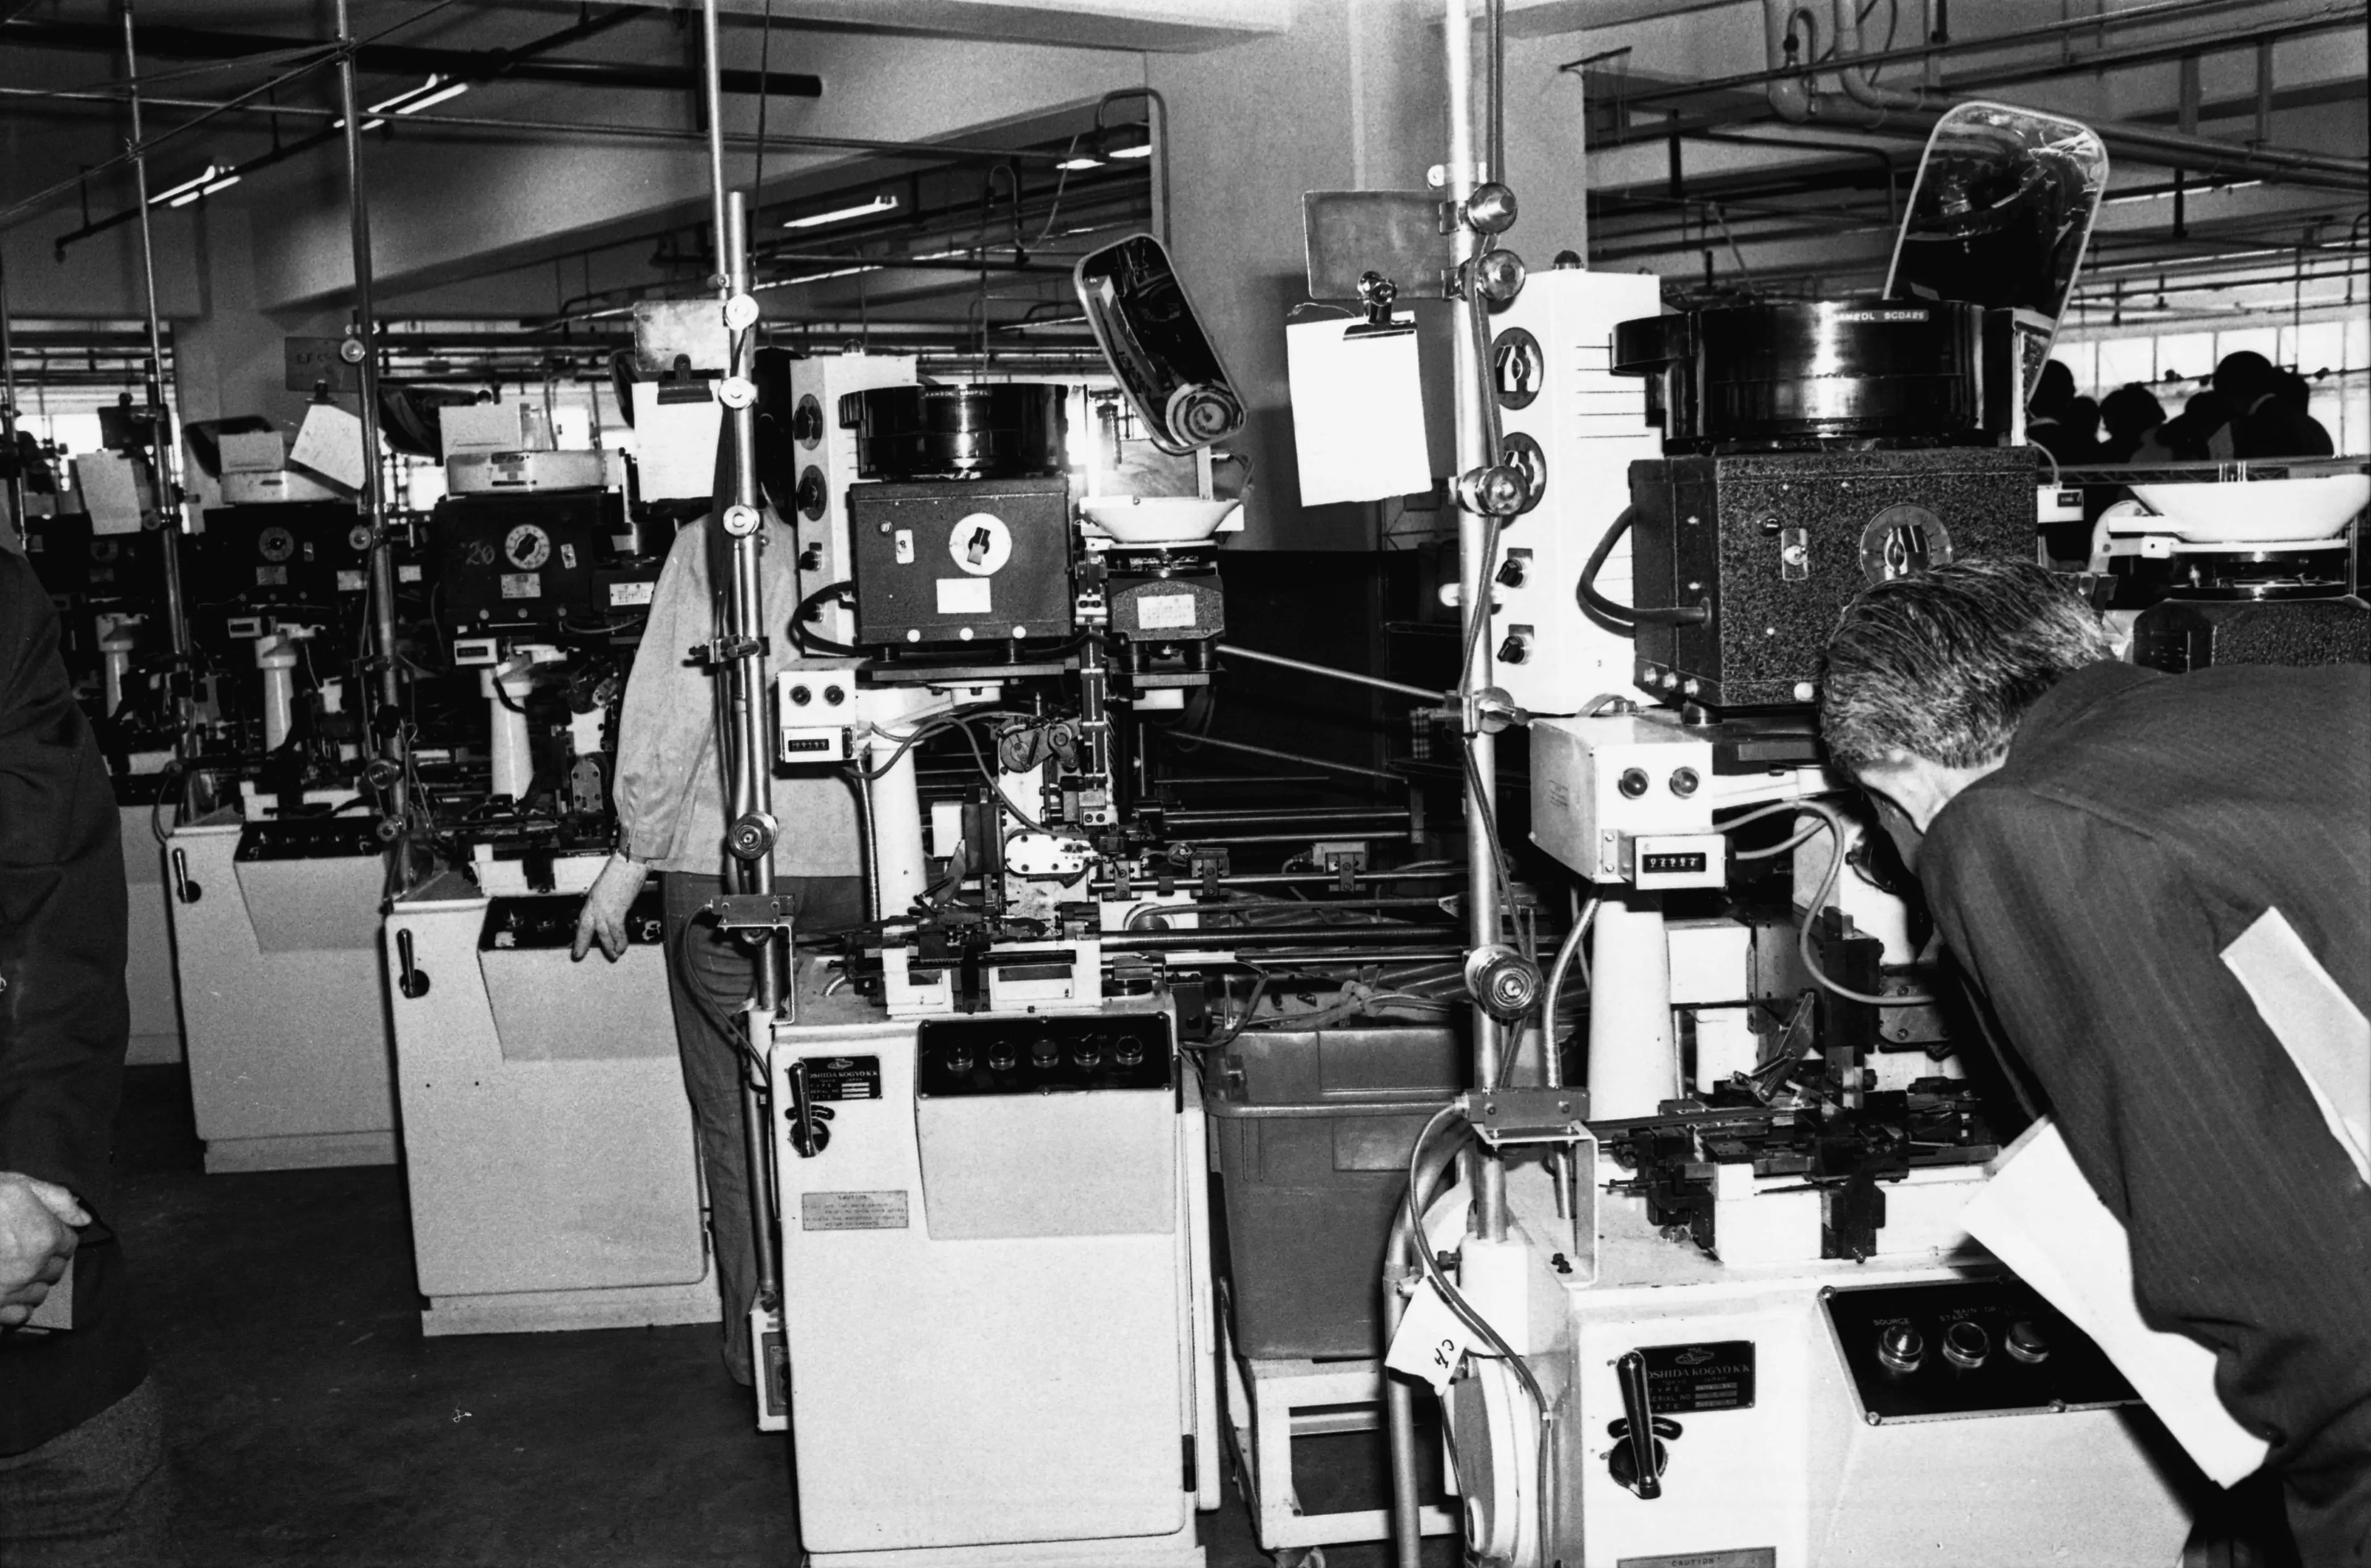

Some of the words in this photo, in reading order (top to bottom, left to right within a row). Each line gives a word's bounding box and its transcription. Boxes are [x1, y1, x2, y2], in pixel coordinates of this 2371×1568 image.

[1873, 1317, 1911, 1325] SOURCE
[1647, 1369, 1689, 1378] OSHIDA
[1692, 1366, 1731, 1376] KOGYO
